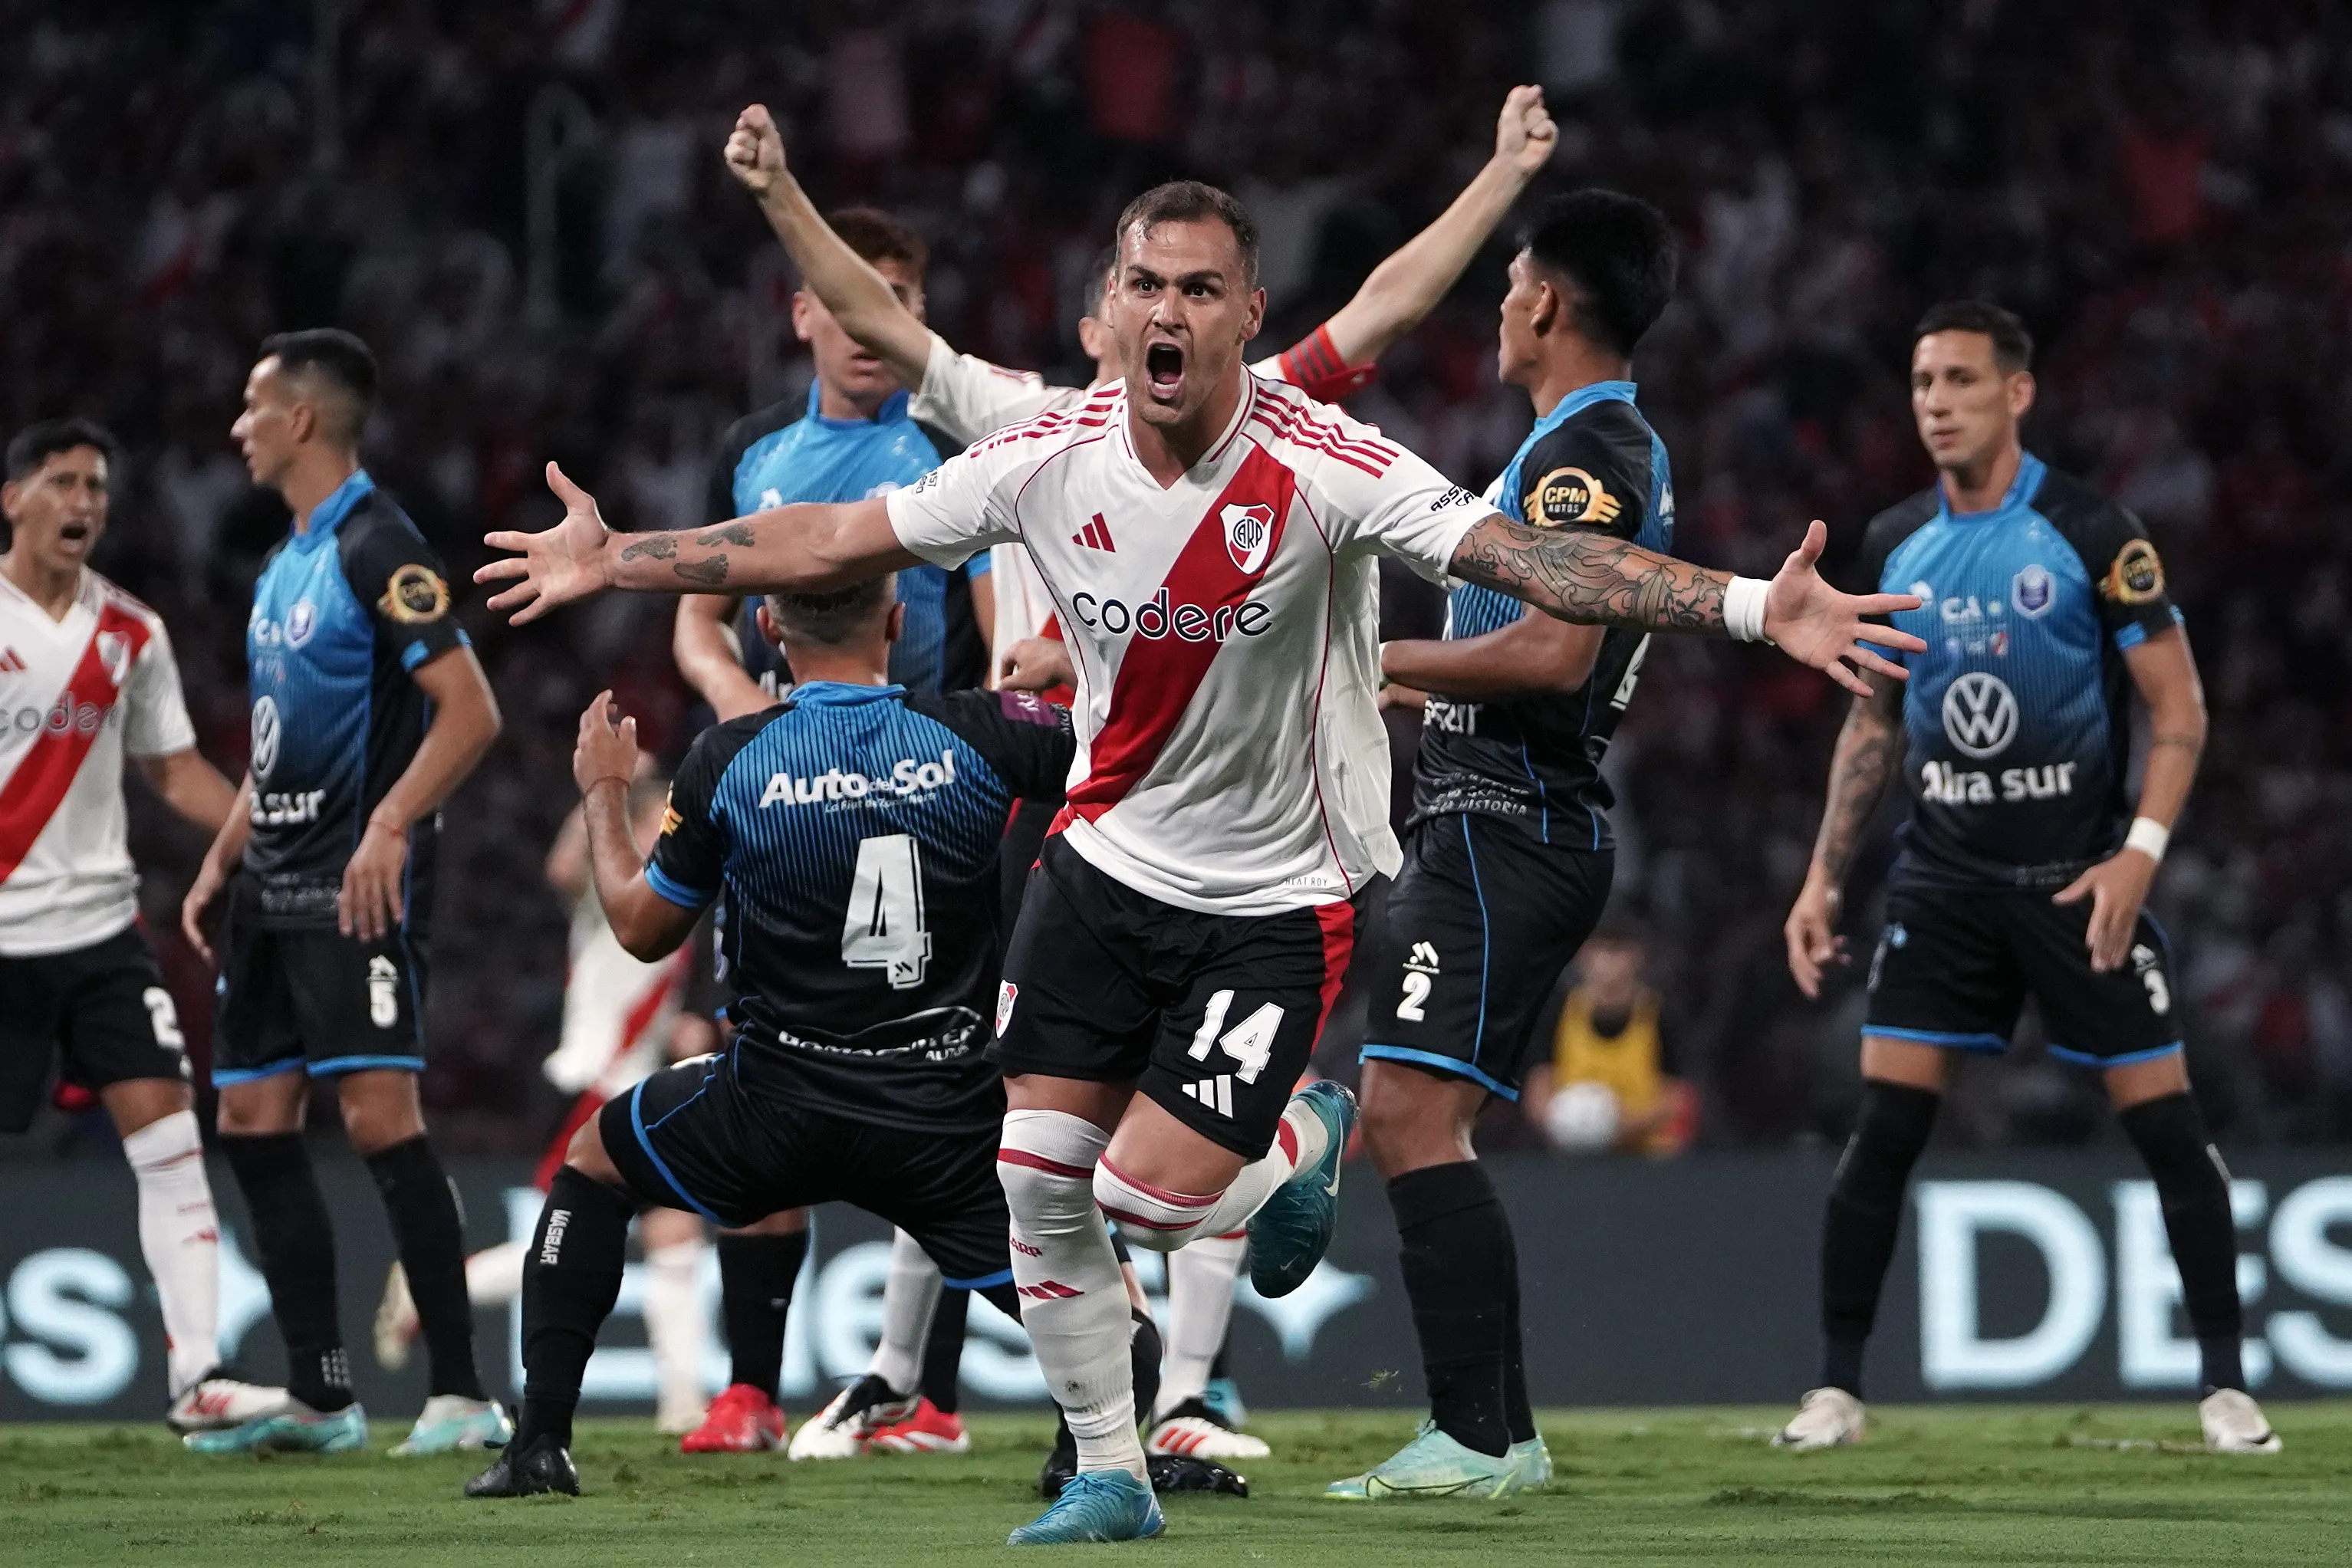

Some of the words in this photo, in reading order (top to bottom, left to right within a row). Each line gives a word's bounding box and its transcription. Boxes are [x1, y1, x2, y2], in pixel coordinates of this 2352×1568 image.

[1544, 485, 1587, 504] CPM
[1072, 587, 1274, 643] codere
[2000, 761, 2077, 800] sur
[842, 833, 933, 989] 4
[142, 986, 185, 1050] 2
[369, 981, 399, 1029] 5
[1396, 971, 1433, 1023] 2
[1187, 989, 1285, 1085] 14
[539, 1208, 573, 1266] MASBAR
